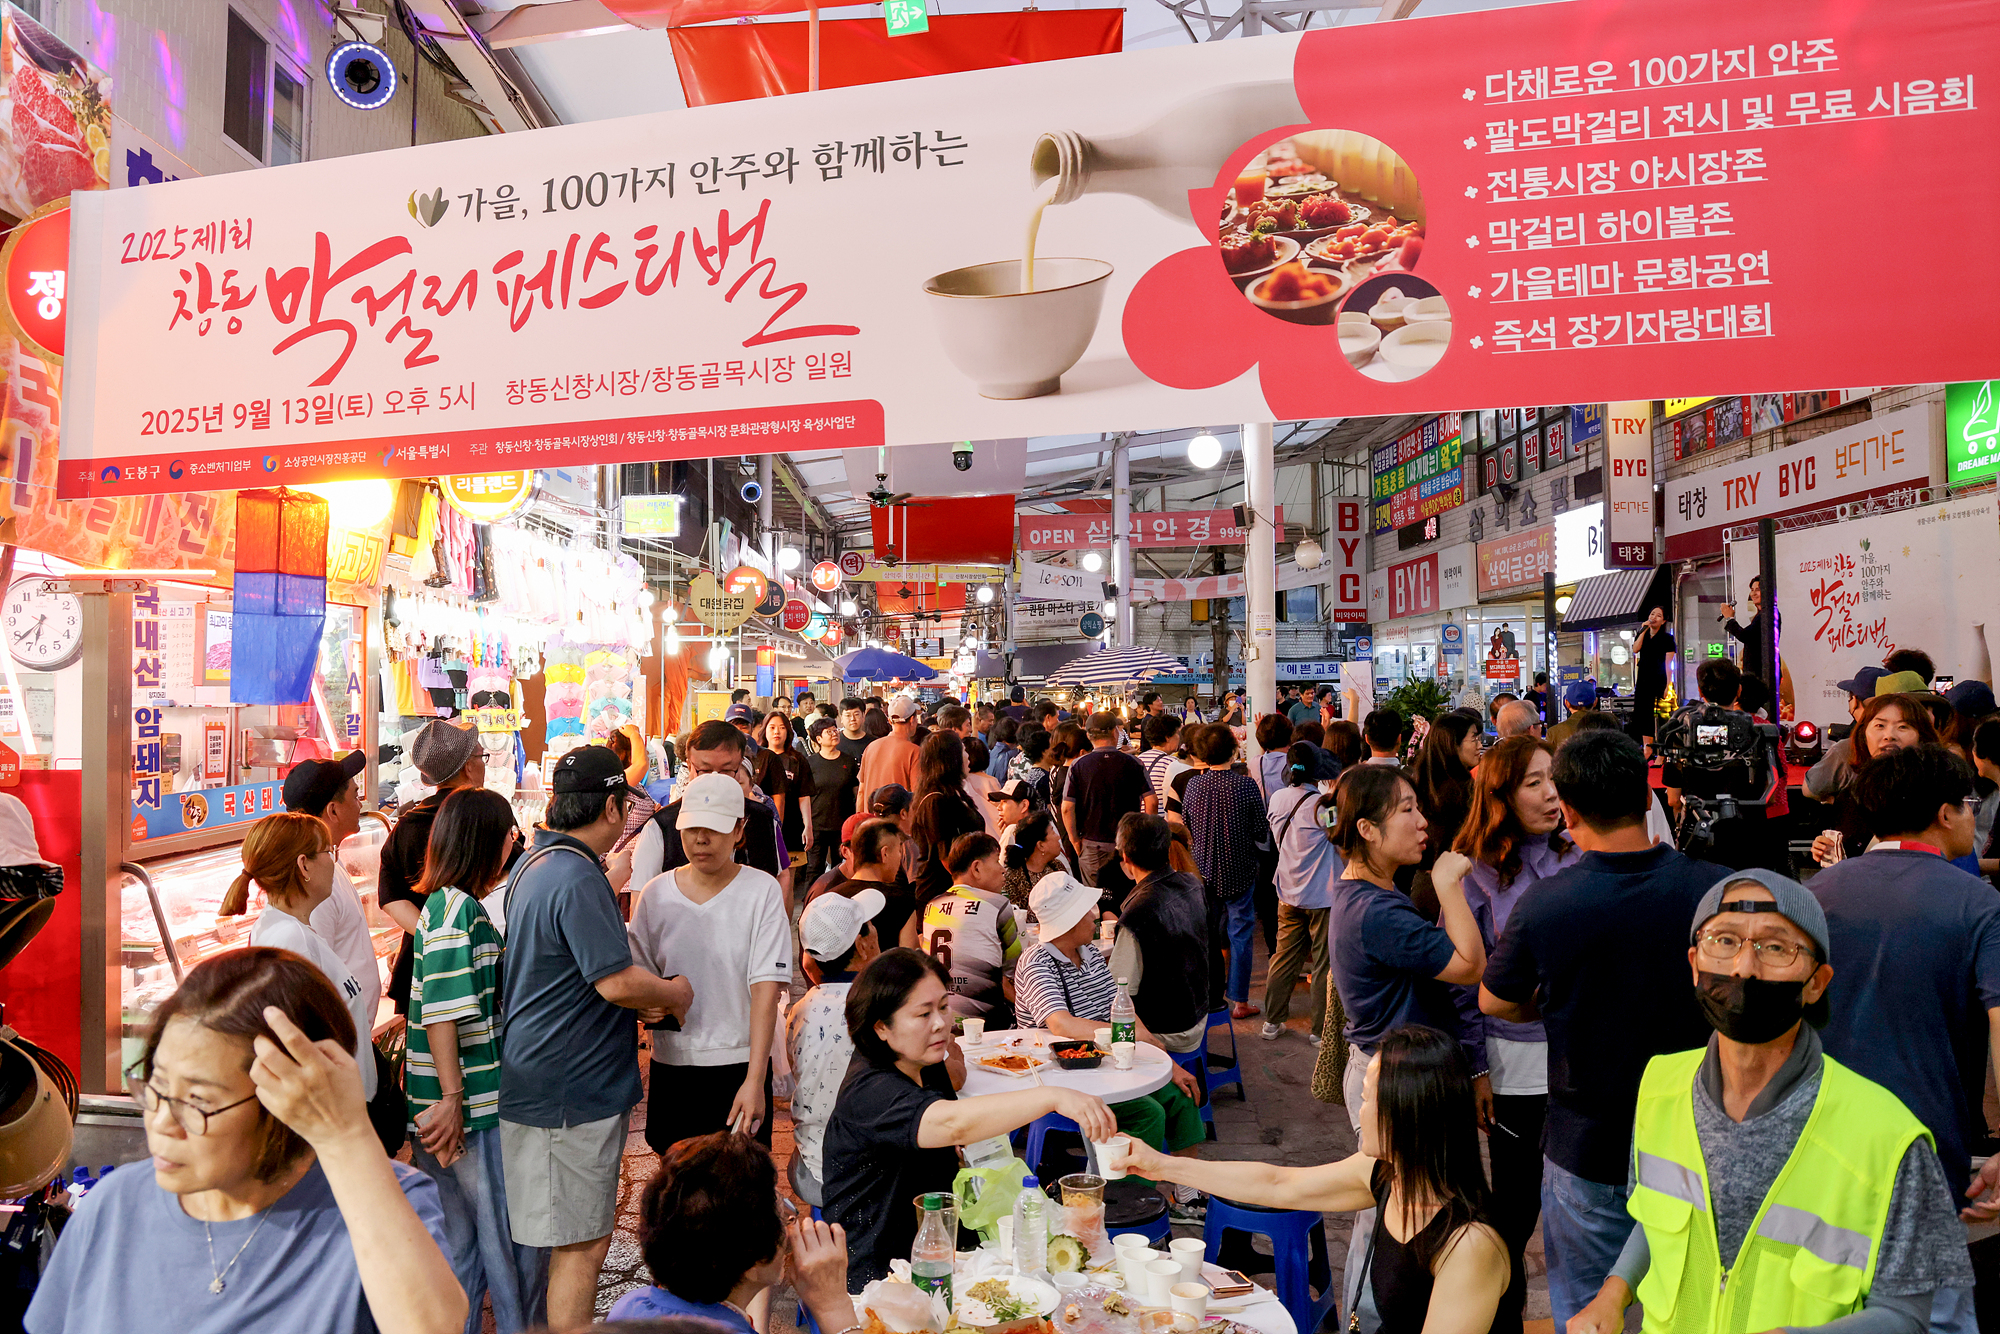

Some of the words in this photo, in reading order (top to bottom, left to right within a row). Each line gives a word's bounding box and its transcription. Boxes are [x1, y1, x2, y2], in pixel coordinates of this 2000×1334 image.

[1485, 59, 1616, 101] 다채로운
[1628, 45, 1755, 89] 100가지
[1768, 37, 1838, 76] 안주
[1485, 105, 1651, 153] 팔도막걸리
[1661, 98, 1730, 137] 전시
[1742, 94, 1774, 131] 및
[1785, 89, 1856, 126] 무료
[1867, 74, 1975, 115] 시음회
[457, 183, 528, 221] 가을,
[541, 162, 676, 214] 100가지
[689, 147, 800, 195] 안주와
[812, 129, 968, 181] 함께하는
[1486, 160, 1620, 202] 전통시장
[1630, 147, 1767, 189] 야시장존
[1488, 212, 1586, 251] 막걸리
[1597, 202, 1734, 242] 하이볼존
[120, 217, 253, 264] 2025제1회
[1490, 261, 1624, 302] 가을테마
[1633, 250, 1770, 294] 문화공연
[168, 262, 258, 337] 창동
[265, 231, 478, 388] 막걸리
[492, 198, 860, 347] 페스티벌
[1492, 316, 1557, 353] 즉석
[1567, 302, 1773, 348] 장기자랑대회
[505, 354, 796, 406] 창동신창시장/창동골목시장
[804, 350, 853, 383] 일원
[141, 403, 224, 436] 2025년
[233, 398, 271, 431] 9월
[282, 390, 373, 425] 13일(토)
[382, 385, 430, 416] 오후
[439, 381, 476, 411] 5시
[1612, 418, 1646, 435] TRY
[78, 470, 96, 482] 주최
[124, 464, 161, 480] 도봉구
[189, 459, 251, 476] 중소벤처기업부
[284, 451, 367, 468] 소상공인시장진흥공단
[396, 443, 450, 459] 서울특별시
[469, 442, 488, 456] 주관
[729, 418, 801, 437] 문화관광형시장
[803, 415, 856, 432] 육성사업단
[1375, 466, 1405, 497] 겨울용품
[1440, 438, 1461, 469] 완구
[1486, 447, 1514, 489] DC
[1613, 459, 1647, 476] BYC
[1957, 456, 1989, 472] DREAME
[456, 475, 518, 494] 리틀랜드
[1678, 486, 1707, 522] 태창
[1723, 471, 1761, 511] TRY
[1779, 455, 1815, 498] BYC
[1835, 429, 1904, 480] 보디가드
[1613, 501, 1649, 514] 보디가드
[1030, 529, 1075, 544] OPEN
[1538, 533, 1550, 549] 1F
[1338, 502, 1360, 603] BYC
[1619, 546, 1646, 561] 태창
[813, 567, 839, 586] 전기
[1488, 550, 1550, 587] 삼익금은방
[1861, 564, 1891, 578] 100가지
[1395, 560, 1431, 614] BYC
[1862, 577, 1884, 590] 안주와
[23, 592, 31, 601] 11
[1862, 589, 1892, 602] 함께하는
[13, 604, 22, 613] 10
[62, 601, 70, 610] 2
[8, 617, 16, 626] 9
[67, 616, 75, 625] 3
[1336, 611, 1366, 621] 비와이씨
[14, 630, 22, 640] 8
[62, 629, 70, 639] 4
[134, 583, 163, 688] 국내산
[26, 641, 33, 651] 7
[39, 644, 47, 655] 6
[53, 640, 61, 650] 5
[1286, 663, 1339, 675] 예쁜교회
[134, 707, 163, 808] 암돼지
[930, 929, 953, 973] 6
